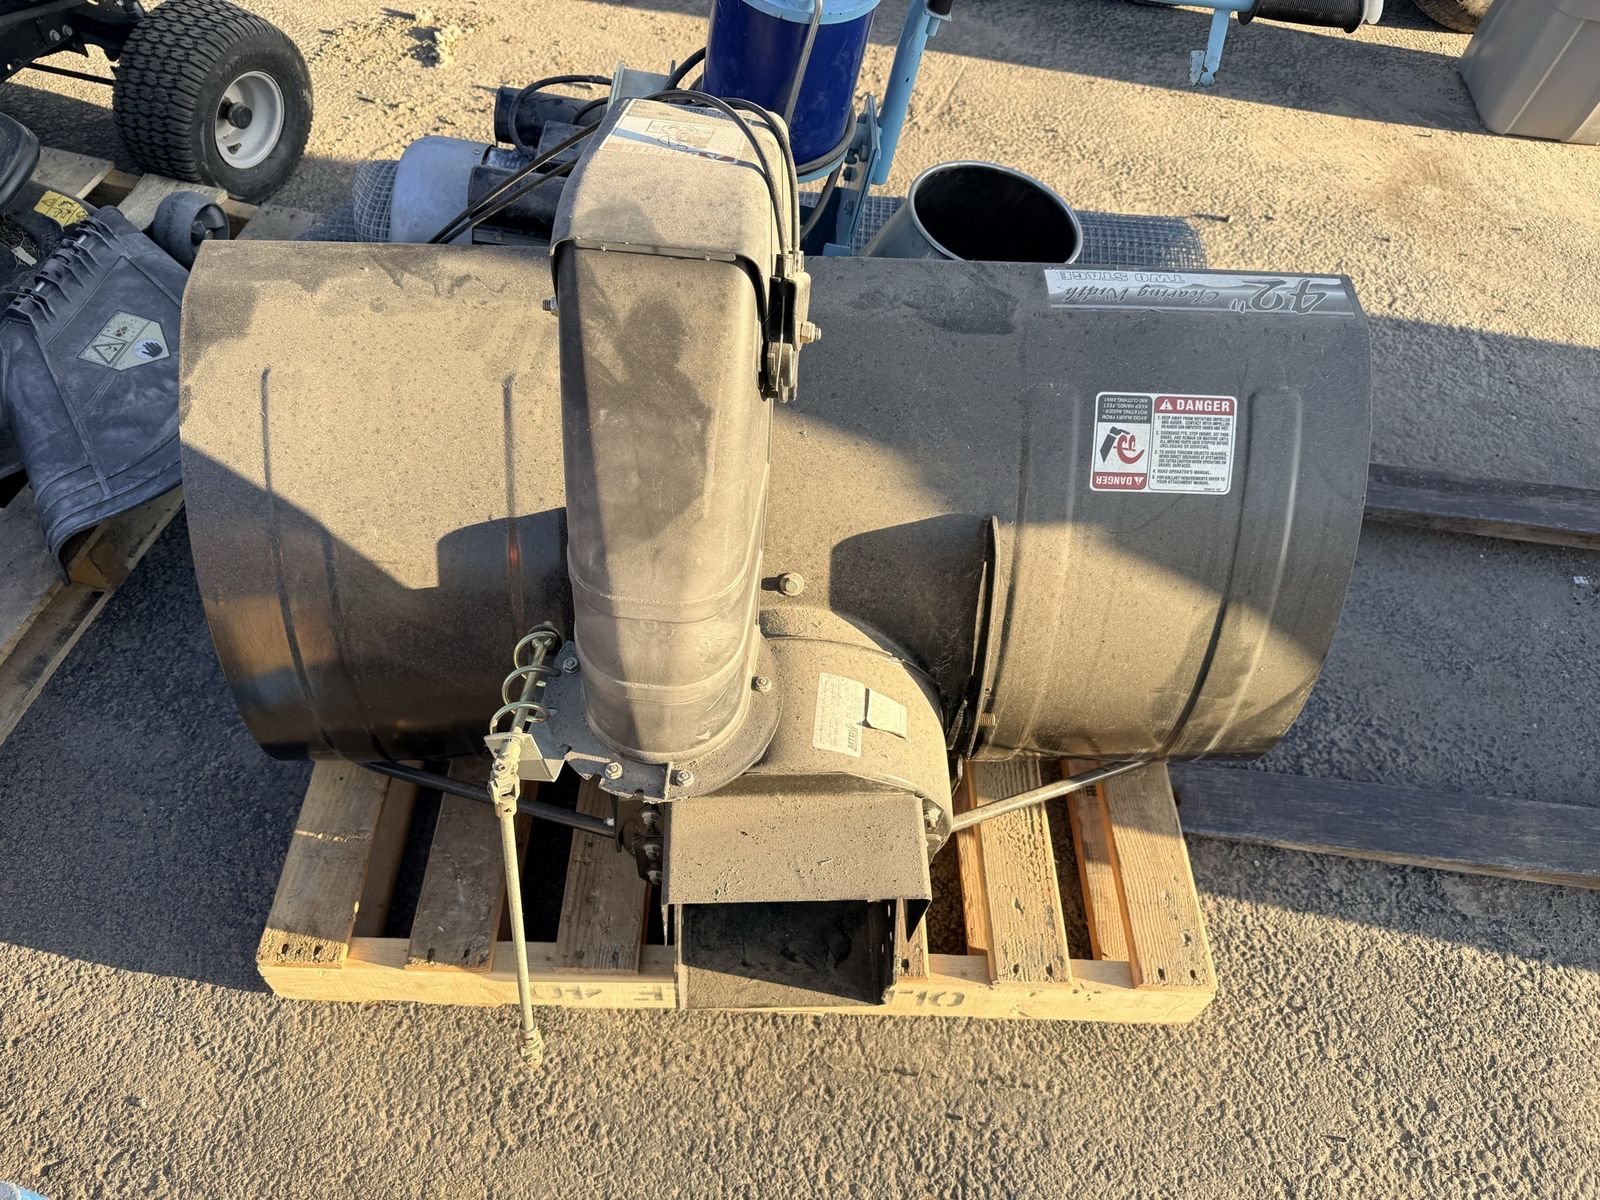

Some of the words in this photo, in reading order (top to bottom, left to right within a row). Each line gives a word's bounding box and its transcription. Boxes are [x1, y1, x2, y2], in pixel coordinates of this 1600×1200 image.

[1059, 271, 1130, 283] STAGE
[1134, 273, 1185, 284] TWO
[1062, 286, 1130, 303] Width
[1136, 285, 1219, 304] Clearing
[1230, 279, 1328, 315] 42"
[1176, 399, 1230, 412] DANGER
[1096, 476, 1132, 485] DANGER
